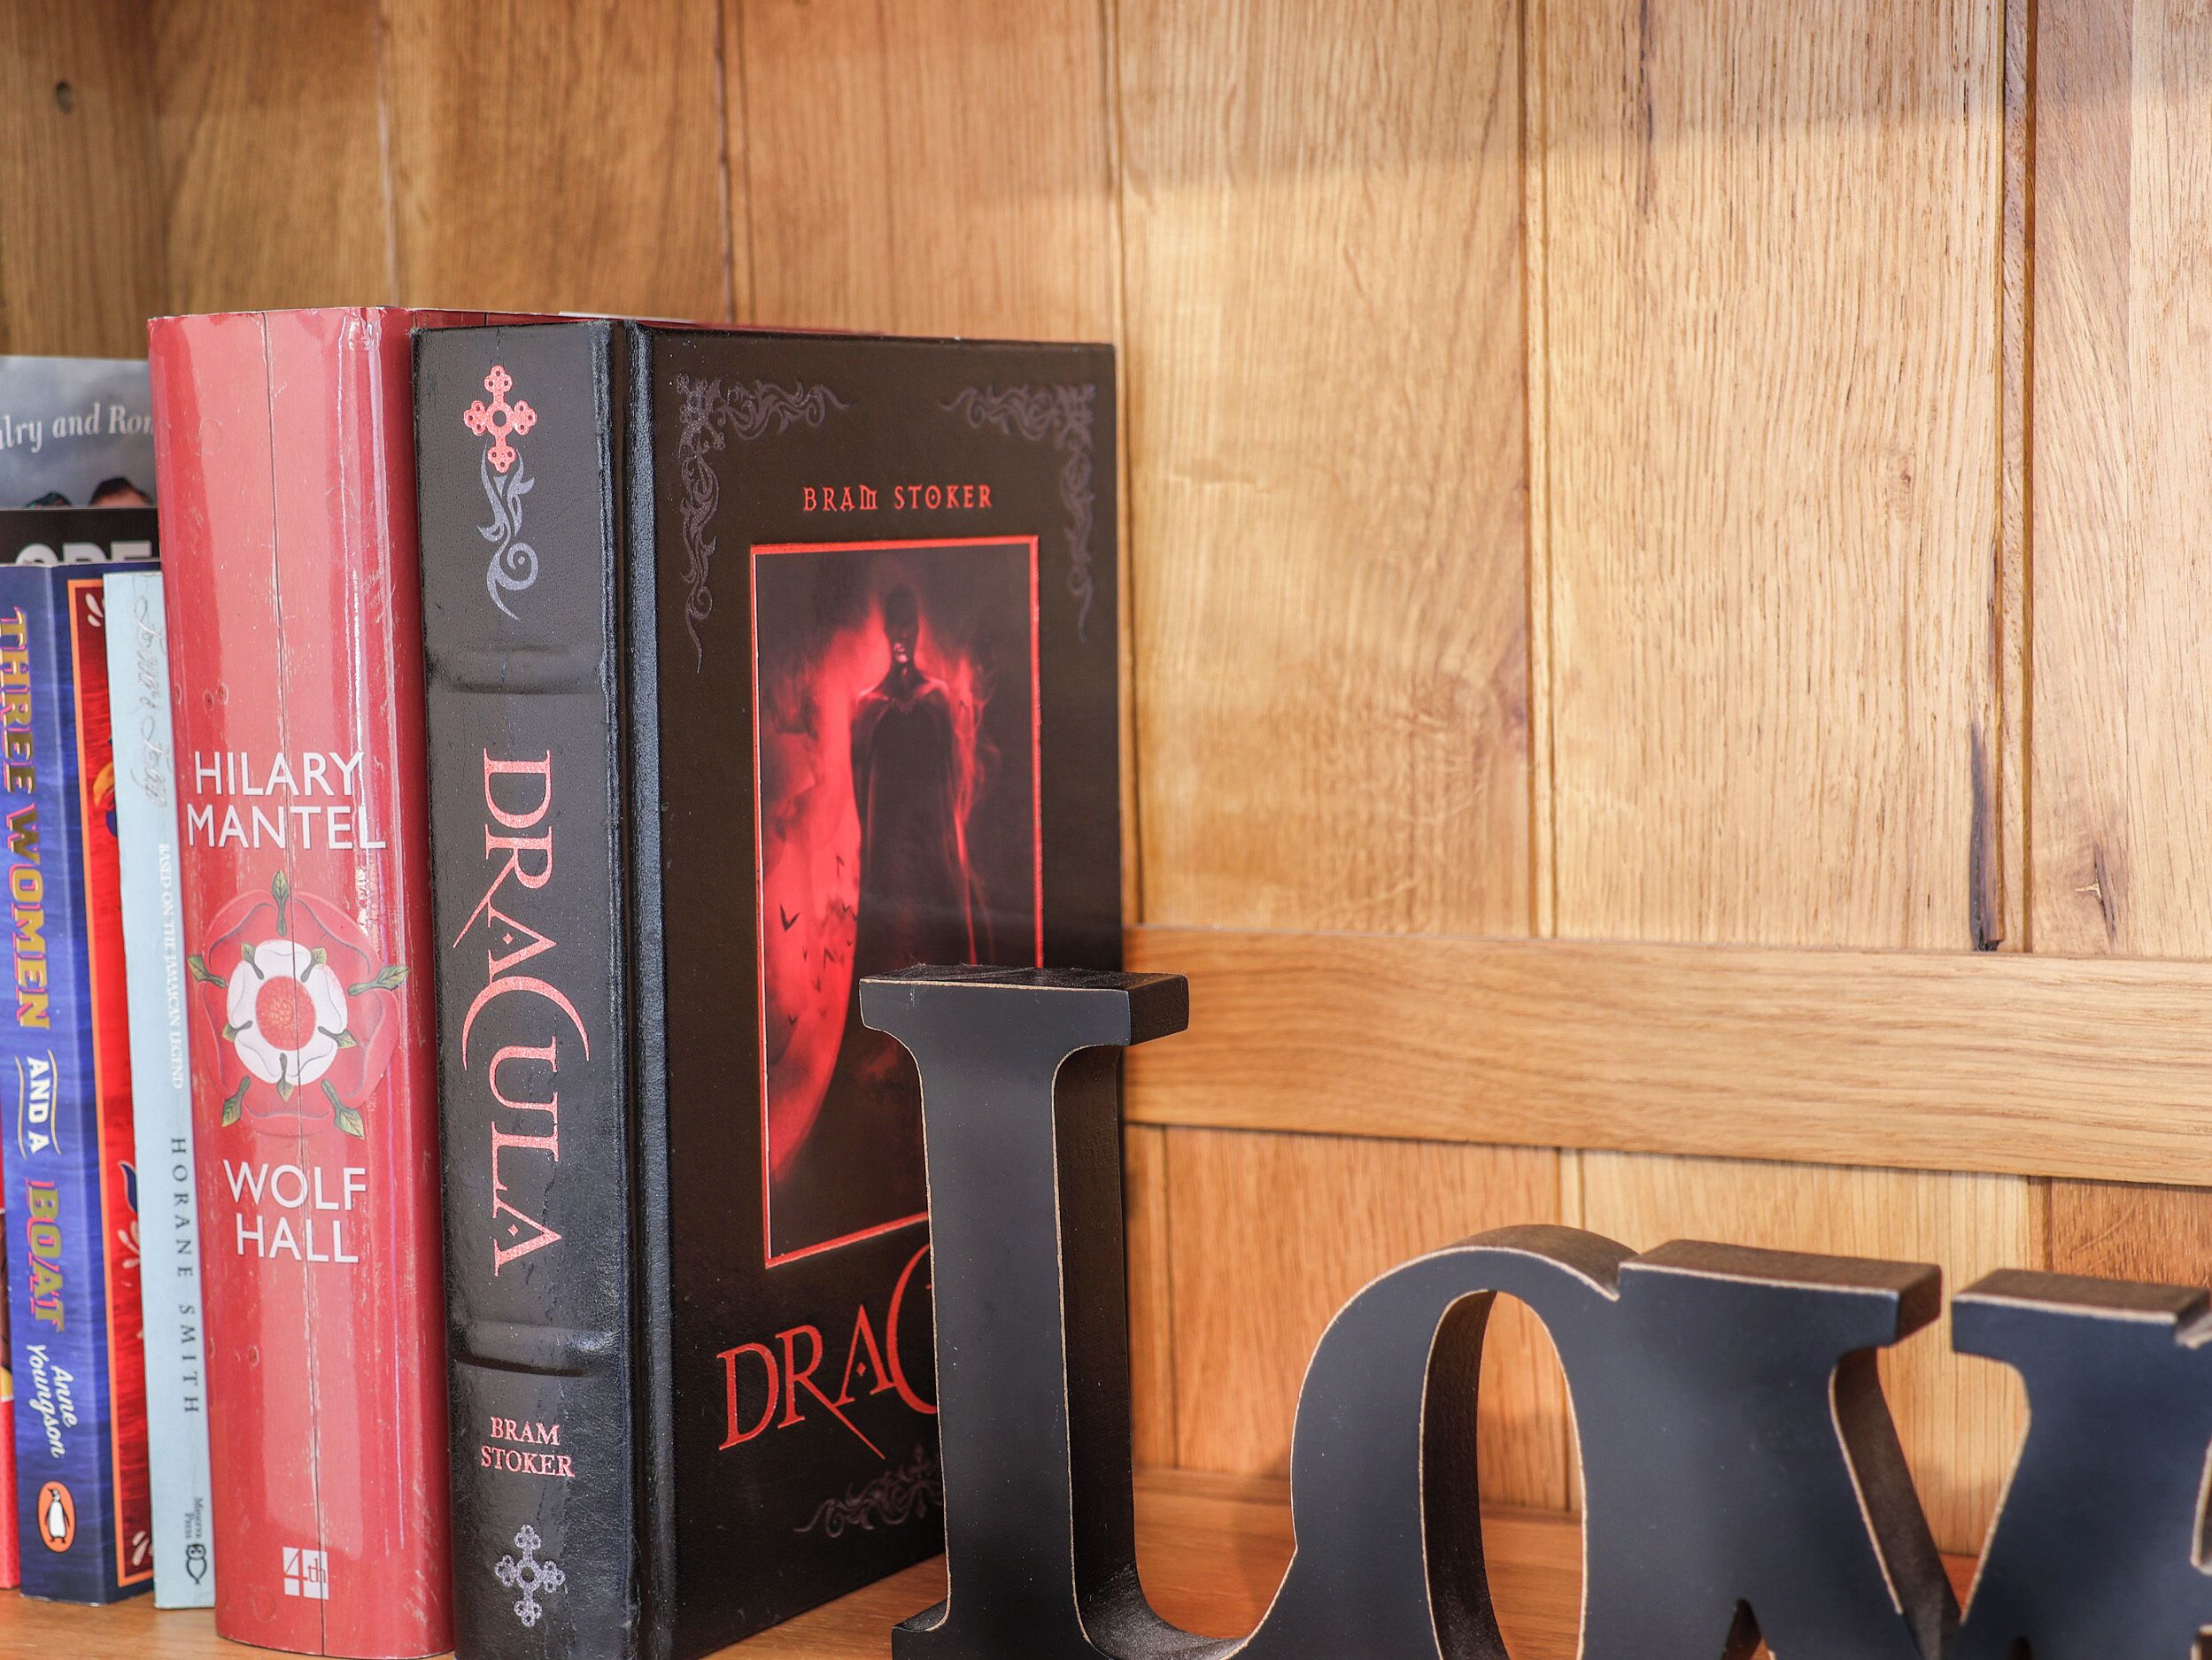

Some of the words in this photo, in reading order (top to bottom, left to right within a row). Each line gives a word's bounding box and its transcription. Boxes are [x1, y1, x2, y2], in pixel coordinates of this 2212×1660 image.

[52, 402, 101, 438] and
[803, 484, 878, 512] BRAM
[893, 484, 993, 510] STOKER
[0, 606, 36, 794] THREE
[194, 751, 364, 797] HILARY
[186, 804, 388, 851] MANTEL
[159, 844, 172, 888] BASED
[6, 802, 50, 1030] WOMEN
[160, 892, 174, 915] ON
[163, 921, 176, 950] THE
[164, 954, 181, 1026] JAMAICAN
[453, 747, 590, 1277] DRACULA
[169, 1031, 183, 1089] LEGEND
[27, 1056, 51, 1124] AND
[27, 1131, 50, 1154] A
[171, 1137, 194, 1278] HORANE
[222, 1159, 367, 1212] WOLF
[25, 1177, 66, 1333] BOAT
[236, 1213, 360, 1263] HALL
[859, 965, 2212, 1660] LOV
[179, 1304, 199, 1413] SMITH
[716, 1243, 937, 1459] DRAC
[26, 1344, 66, 1459] Youngson
[50, 1364, 79, 1428] Anne
[490, 1416, 561, 1446] BRAM
[481, 1445, 576, 1478] STOKER
